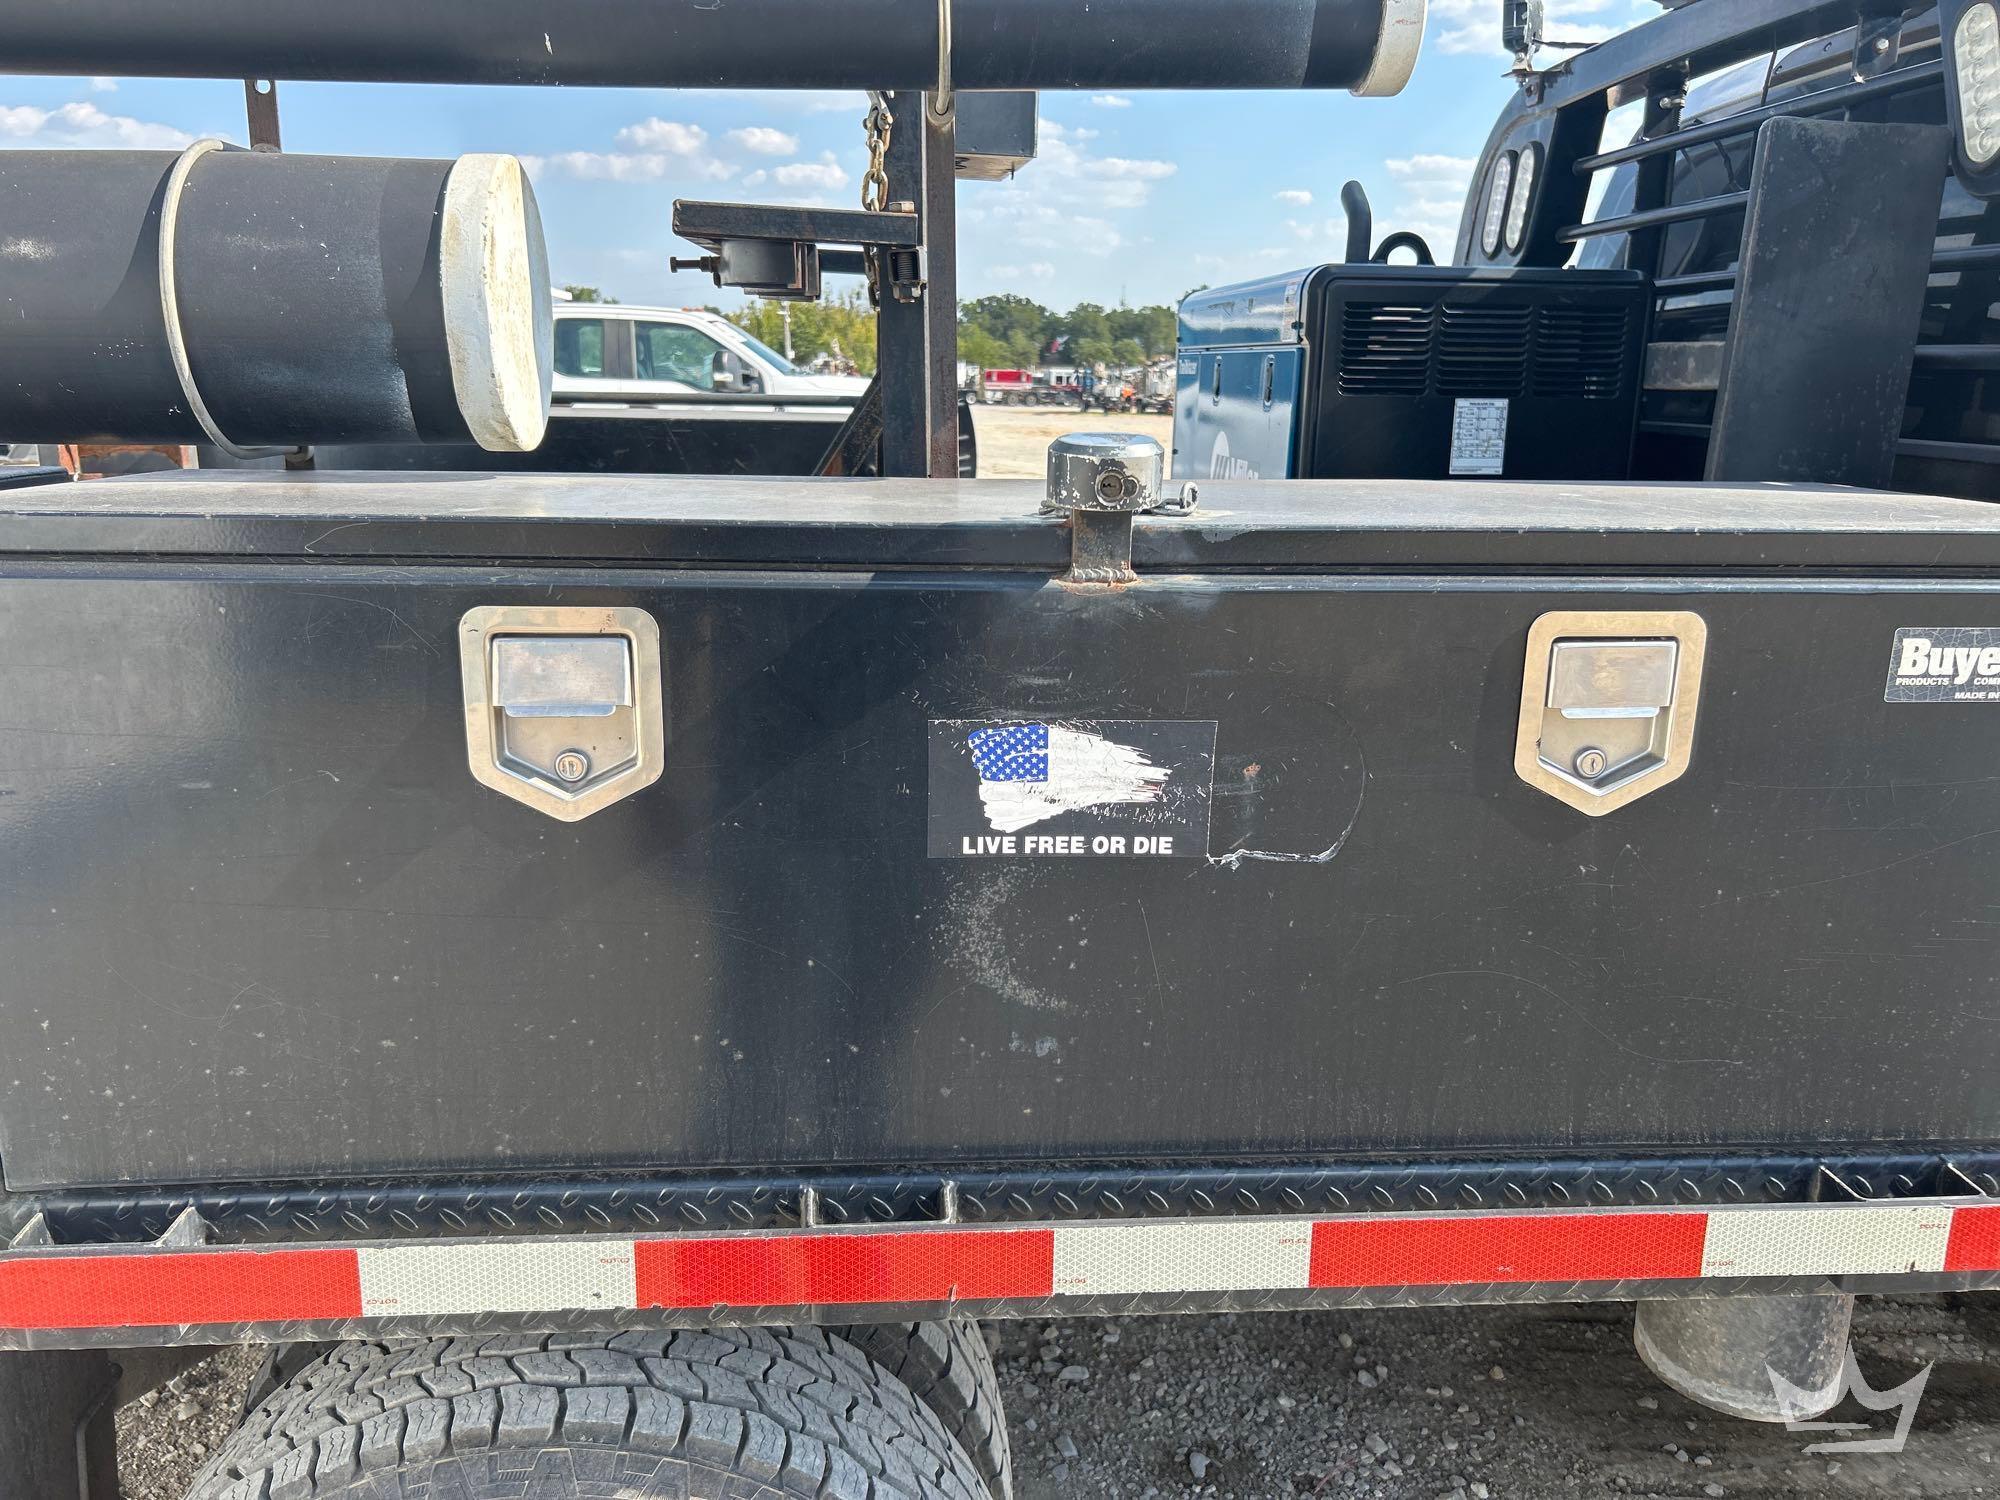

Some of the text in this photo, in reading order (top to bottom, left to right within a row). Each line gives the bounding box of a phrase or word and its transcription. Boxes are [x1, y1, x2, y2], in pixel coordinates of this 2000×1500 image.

[1895, 678, 1949, 686] PRODUCTS
[1954, 691, 1986, 699] MADE
[962, 836, 1173, 855] LIVE FREE OR DIE
